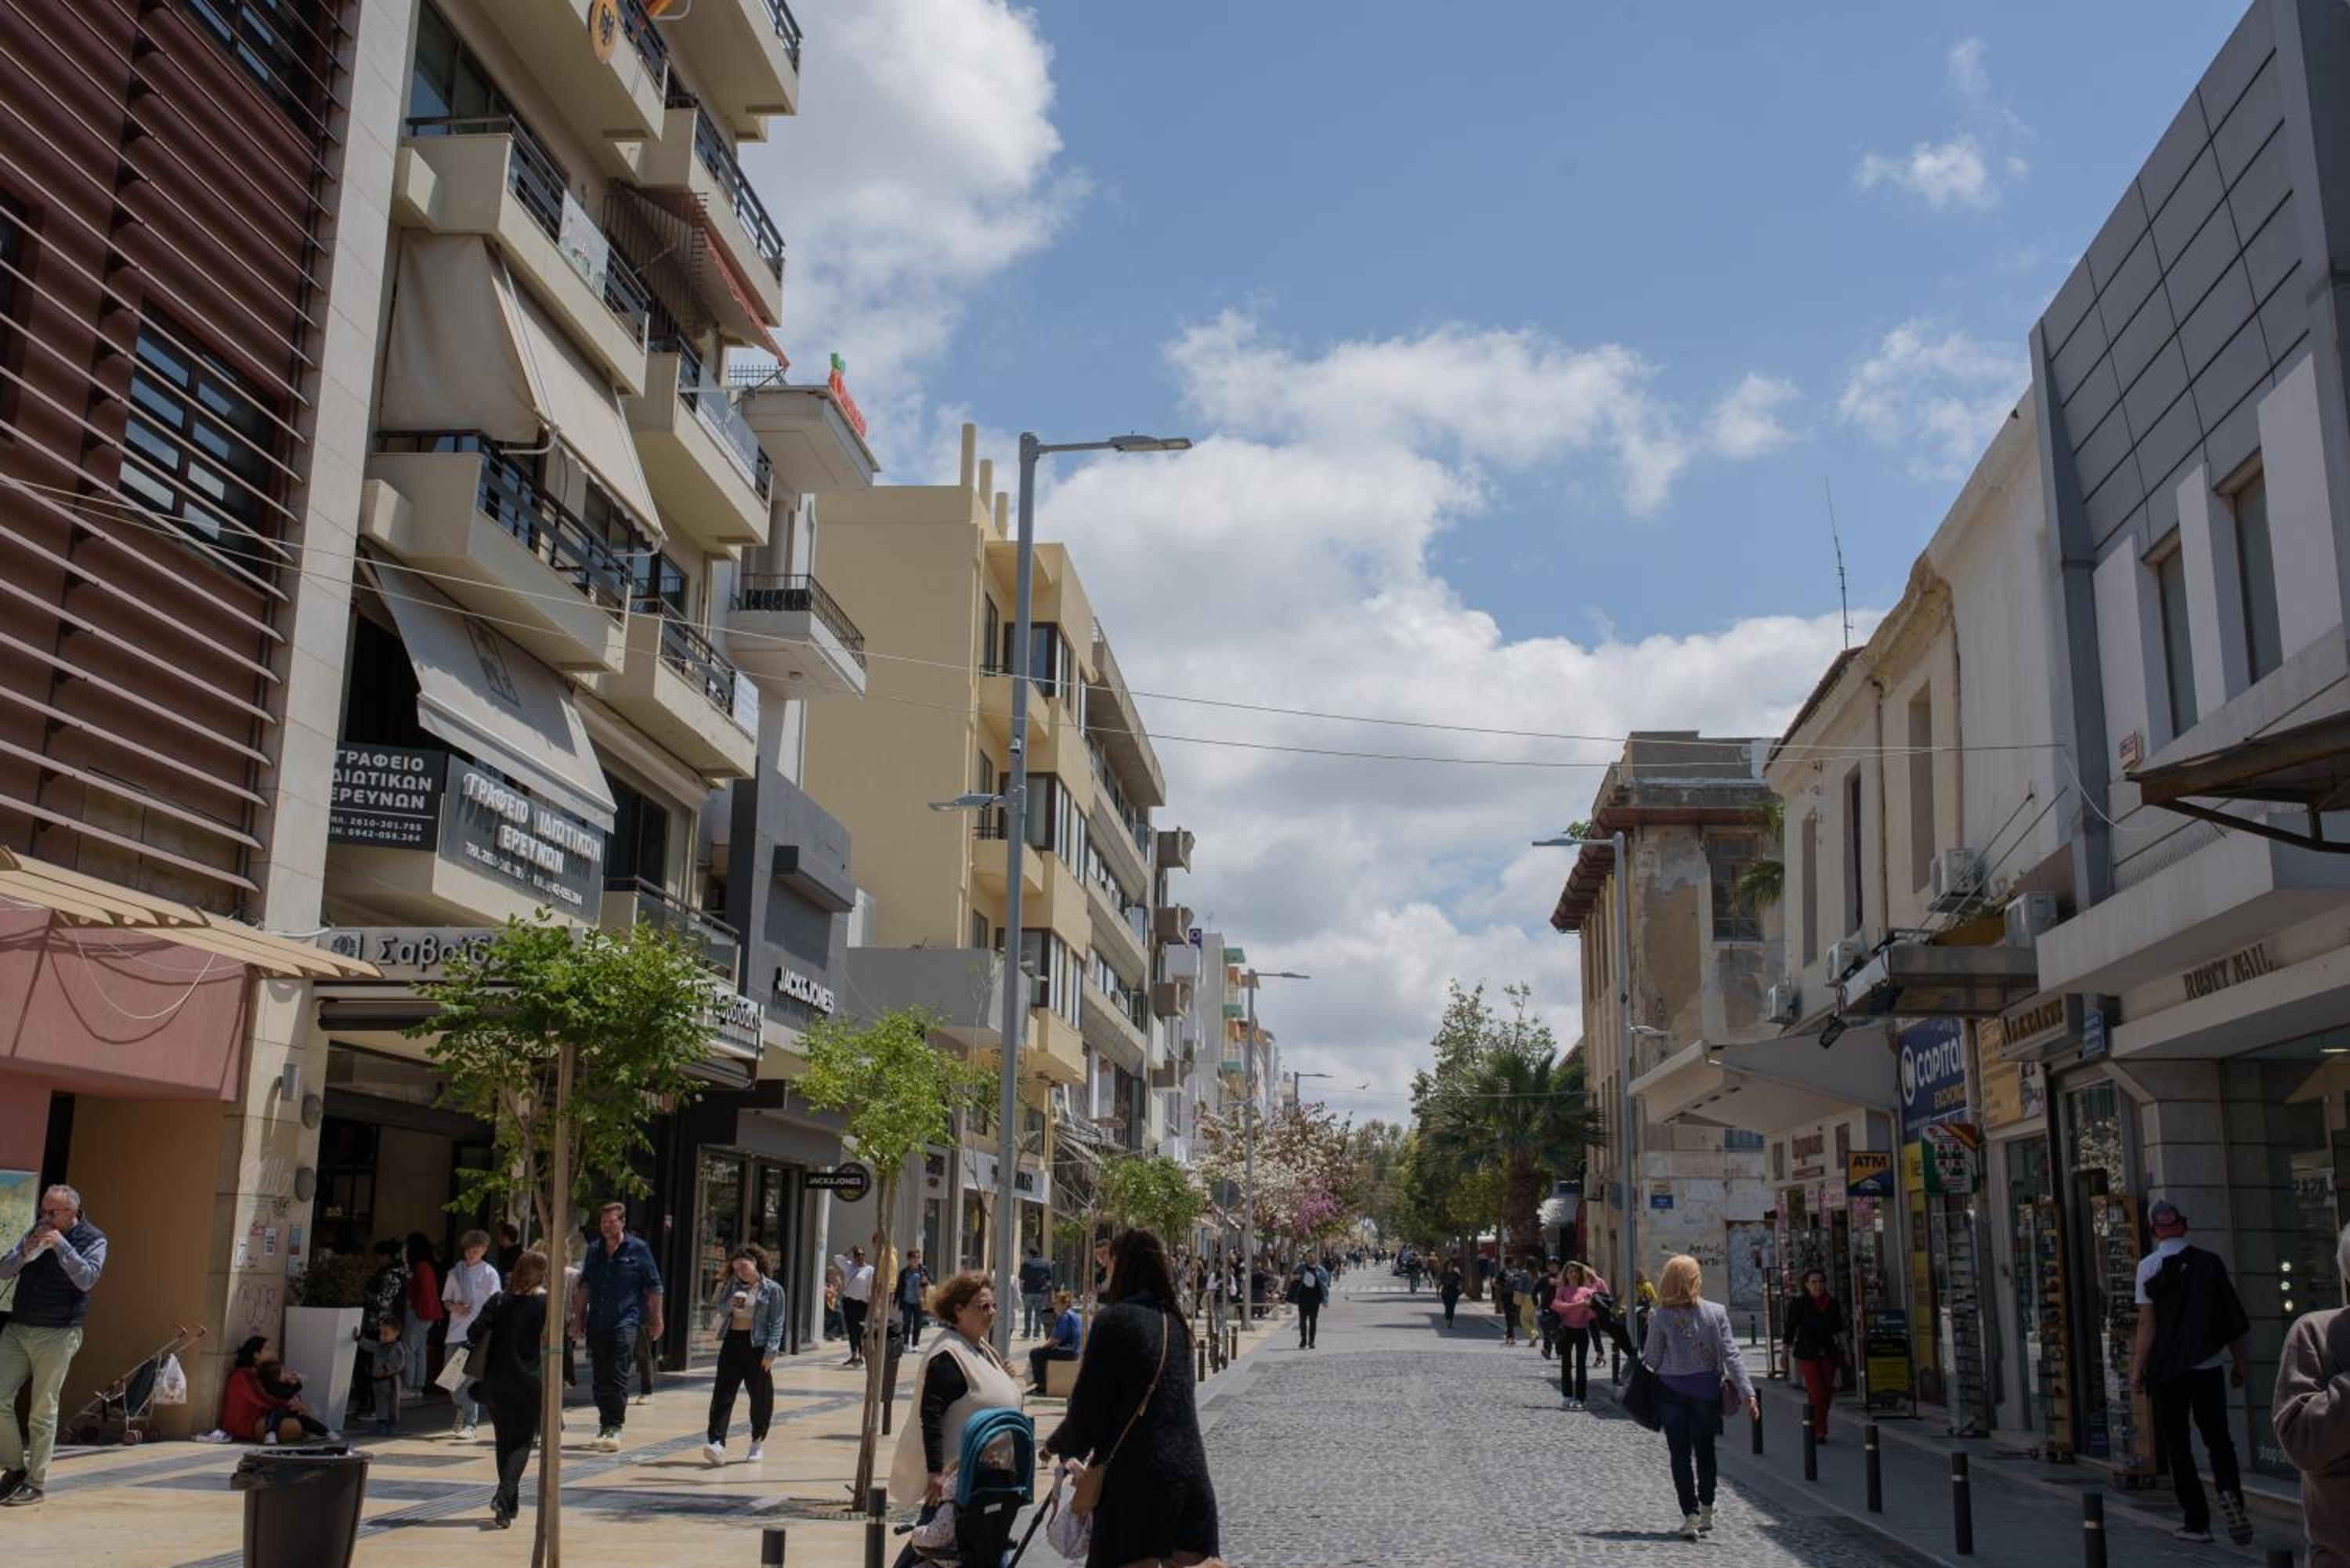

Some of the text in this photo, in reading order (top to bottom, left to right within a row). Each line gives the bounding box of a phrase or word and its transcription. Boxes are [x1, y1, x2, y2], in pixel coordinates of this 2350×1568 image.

[336, 750, 425, 771] ΓΡΑΦΕΙΟ
[334, 768, 432, 791] ΔΙΩΤΙΚΩΝ
[462, 773, 529, 823] ΓΡΑΦΕΙΟ
[497, 825, 565, 874] ΕΡΕΥΝΩΝ
[1854, 1155, 1886, 1166] ATM
